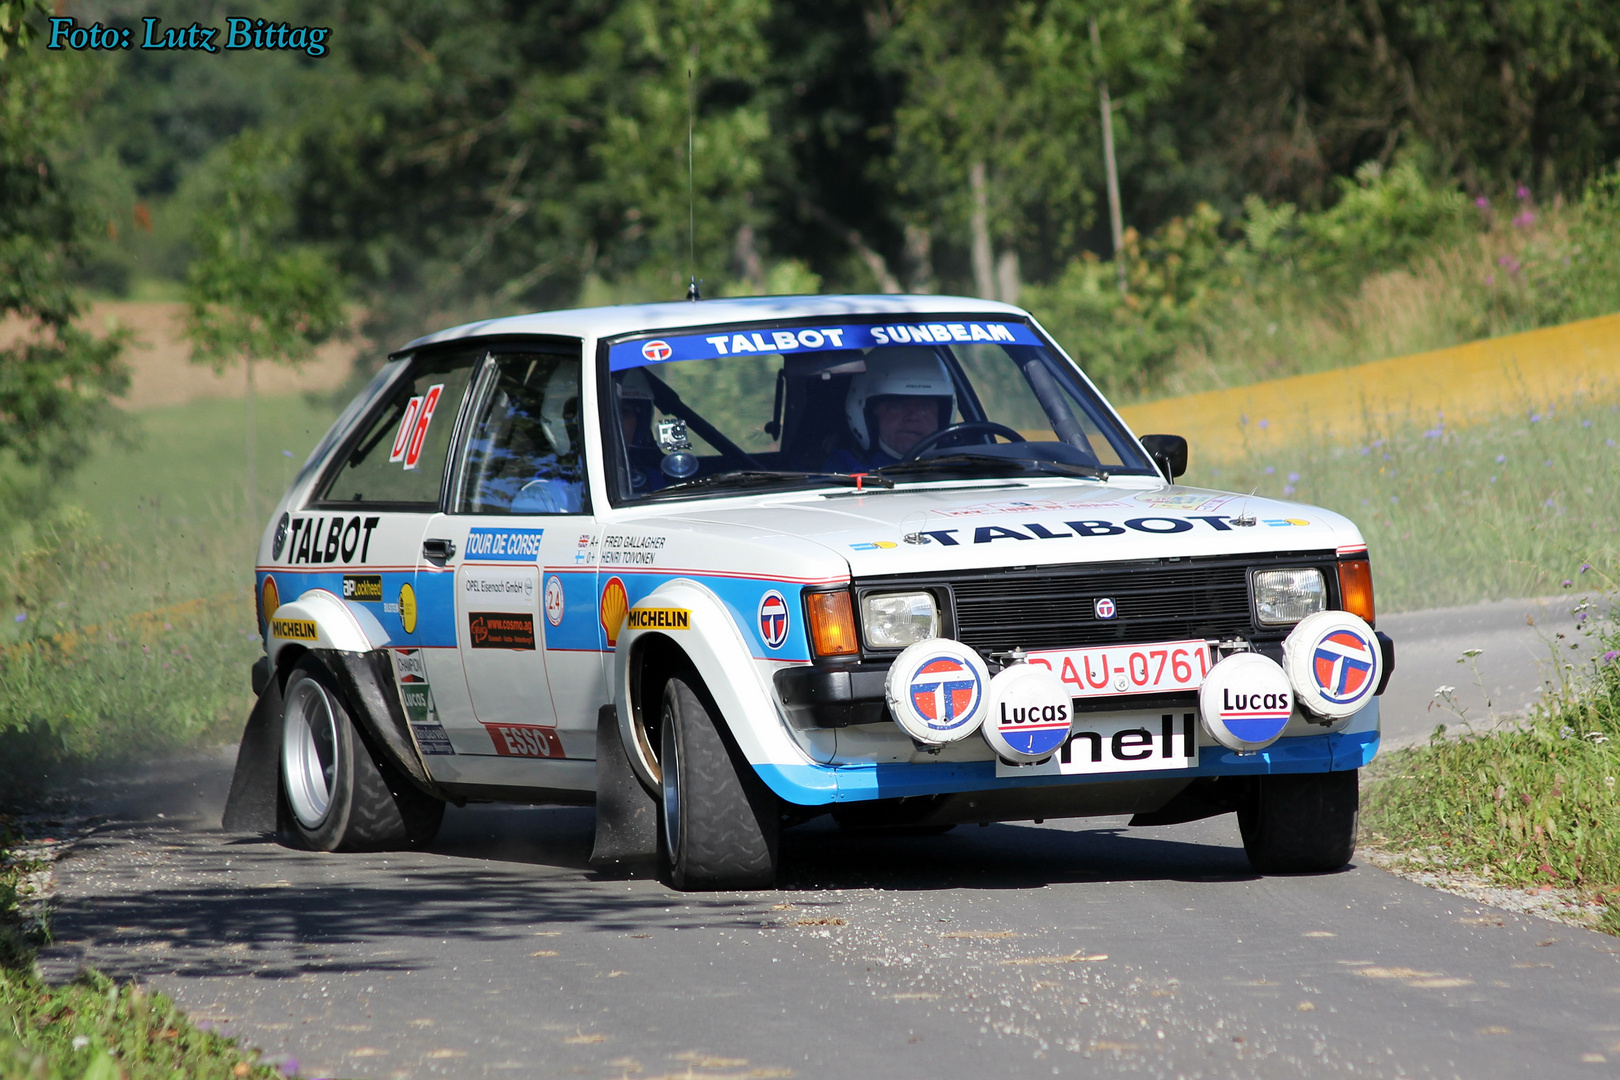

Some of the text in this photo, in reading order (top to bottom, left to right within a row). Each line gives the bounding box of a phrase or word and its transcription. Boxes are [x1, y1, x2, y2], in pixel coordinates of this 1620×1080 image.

[706, 328, 844, 355] TALBOT
[870, 323, 1015, 345] SUNBEAM
[287, 516, 380, 564] TALBOT
[604, 535, 623, 548] FRED
[624, 536, 666, 549] GALLAGHER
[917, 516, 1234, 546] TALBOT
[467, 533, 541, 555] TOUR DE CORSE
[601, 551, 621, 564] HENRI
[622, 551, 655, 564] TOIVONEN
[355, 579, 382, 596] Lockheed
[465, 579, 480, 592] OPEL
[505, 580, 523, 593] GmbH
[272, 620, 316, 638] MICHELIN
[486, 619, 533, 635] www.cosmo.ag
[628, 610, 688, 628] MICHELIN
[1028, 647, 1206, 690] AU-0761
[402, 688, 427, 707] Lucas
[1223, 688, 1288, 711] Lucas
[1000, 701, 1067, 724] Lucas
[498, 727, 550, 757] ESSO
[1000, 713, 1195, 767] hell
